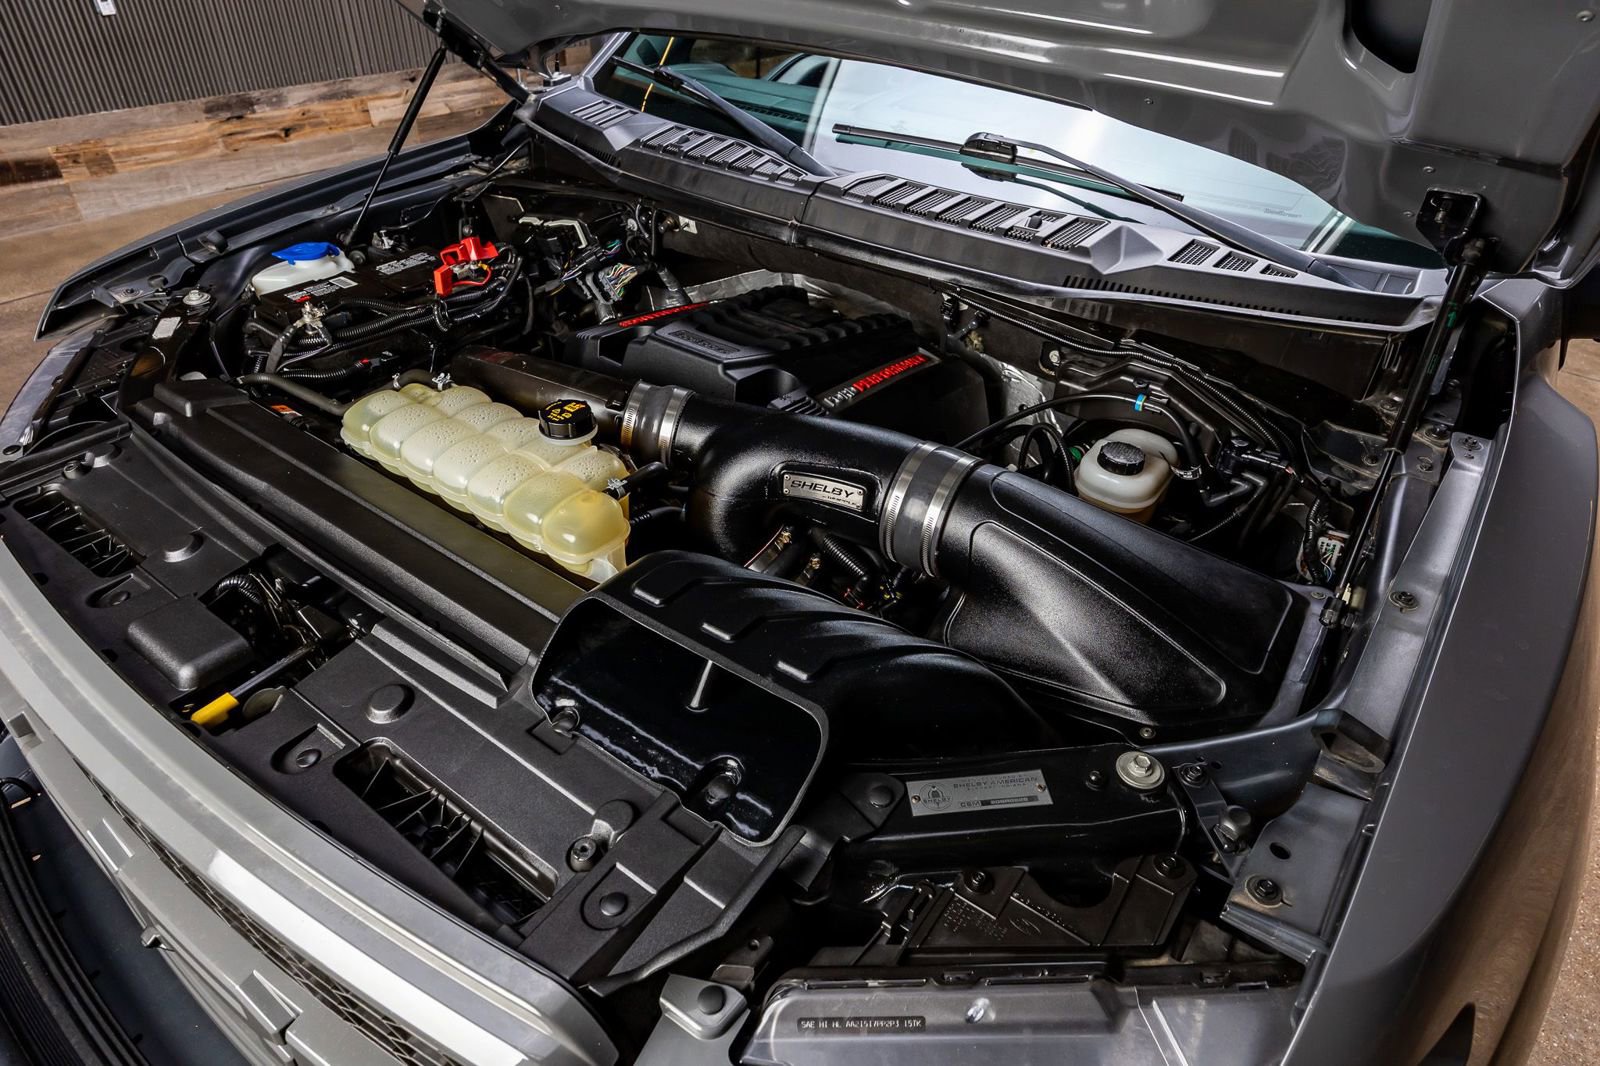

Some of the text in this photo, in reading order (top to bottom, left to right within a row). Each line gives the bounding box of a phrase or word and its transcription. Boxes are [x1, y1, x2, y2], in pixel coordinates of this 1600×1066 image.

[790, 480, 854, 498] SHELBY
[953, 781, 987, 789] SHELBY
[990, 776, 1037, 785] AMERICAN
[800, 1020, 815, 1029] SAE
